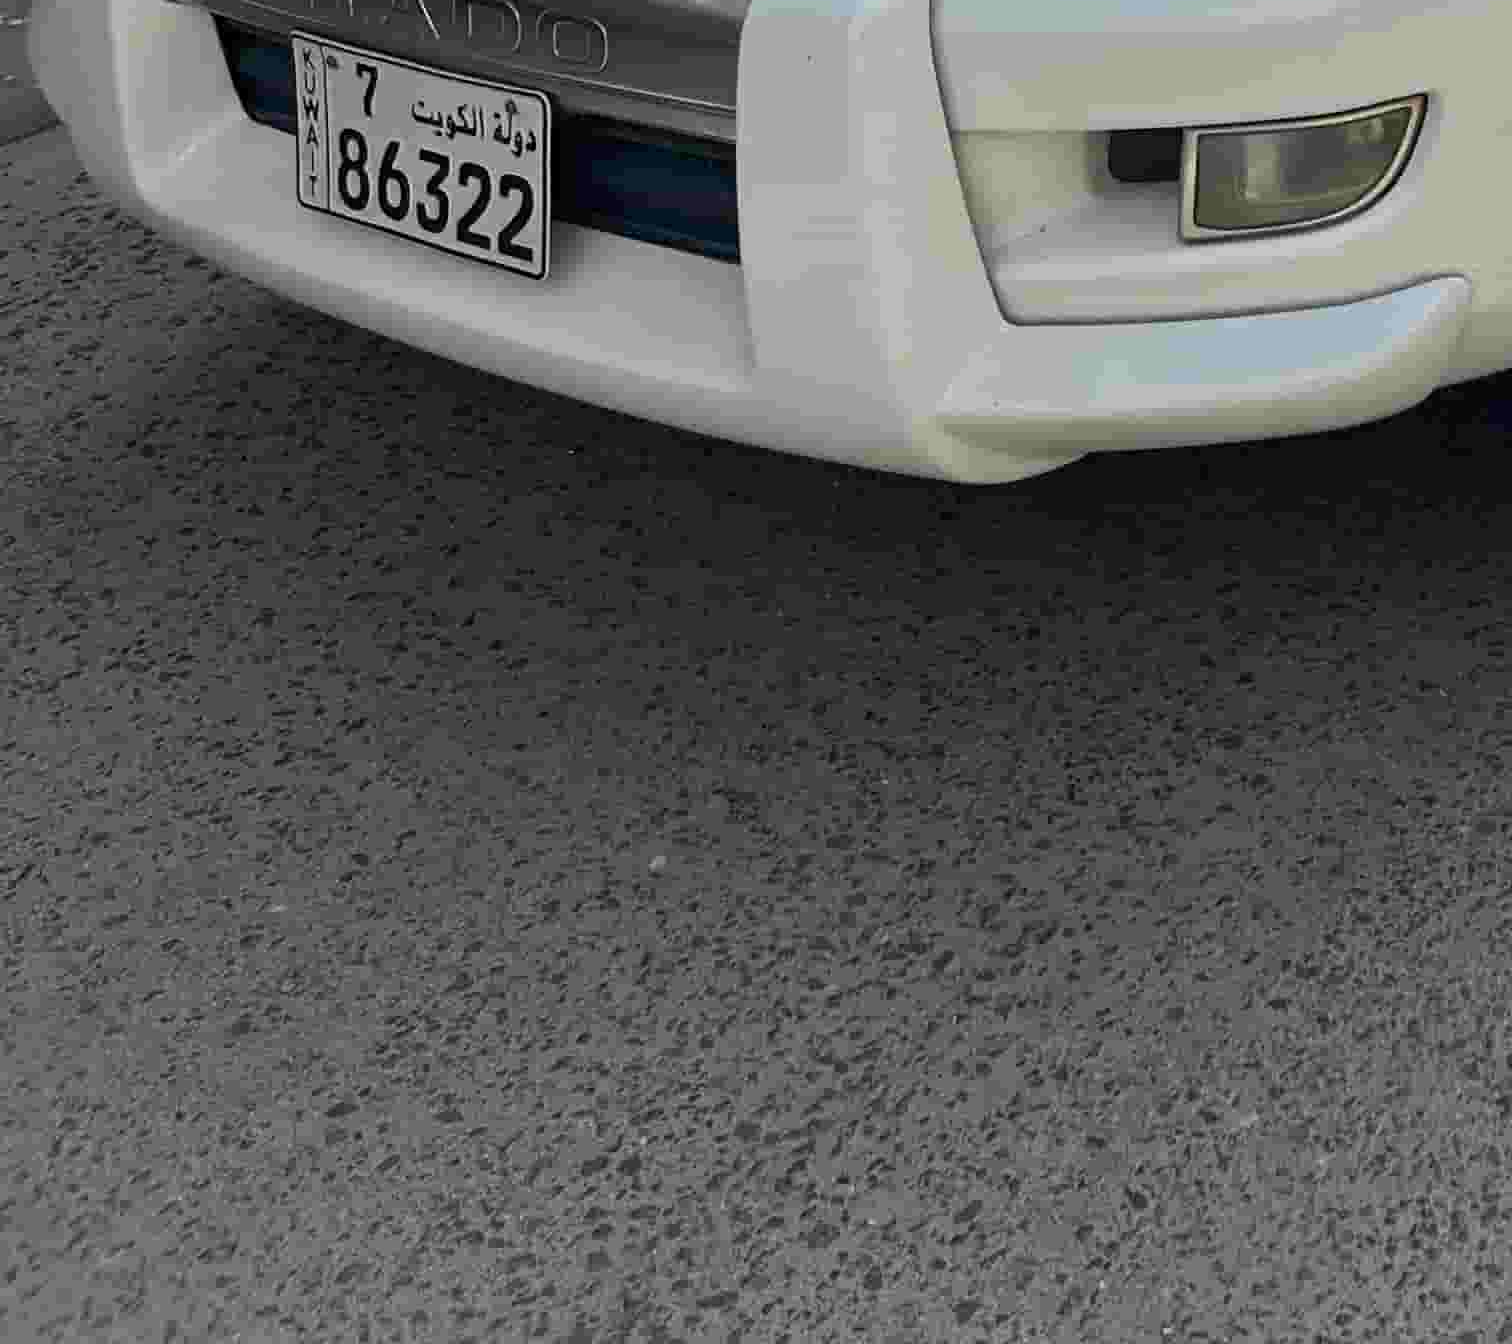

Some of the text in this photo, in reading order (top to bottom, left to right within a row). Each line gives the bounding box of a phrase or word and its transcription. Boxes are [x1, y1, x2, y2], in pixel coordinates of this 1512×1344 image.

[303, 46, 320, 198] KUWAIT
[355, 62, 379, 118] 7
[408, 98, 537, 159] دولة الكويت
[336, 128, 535, 263] 86322
